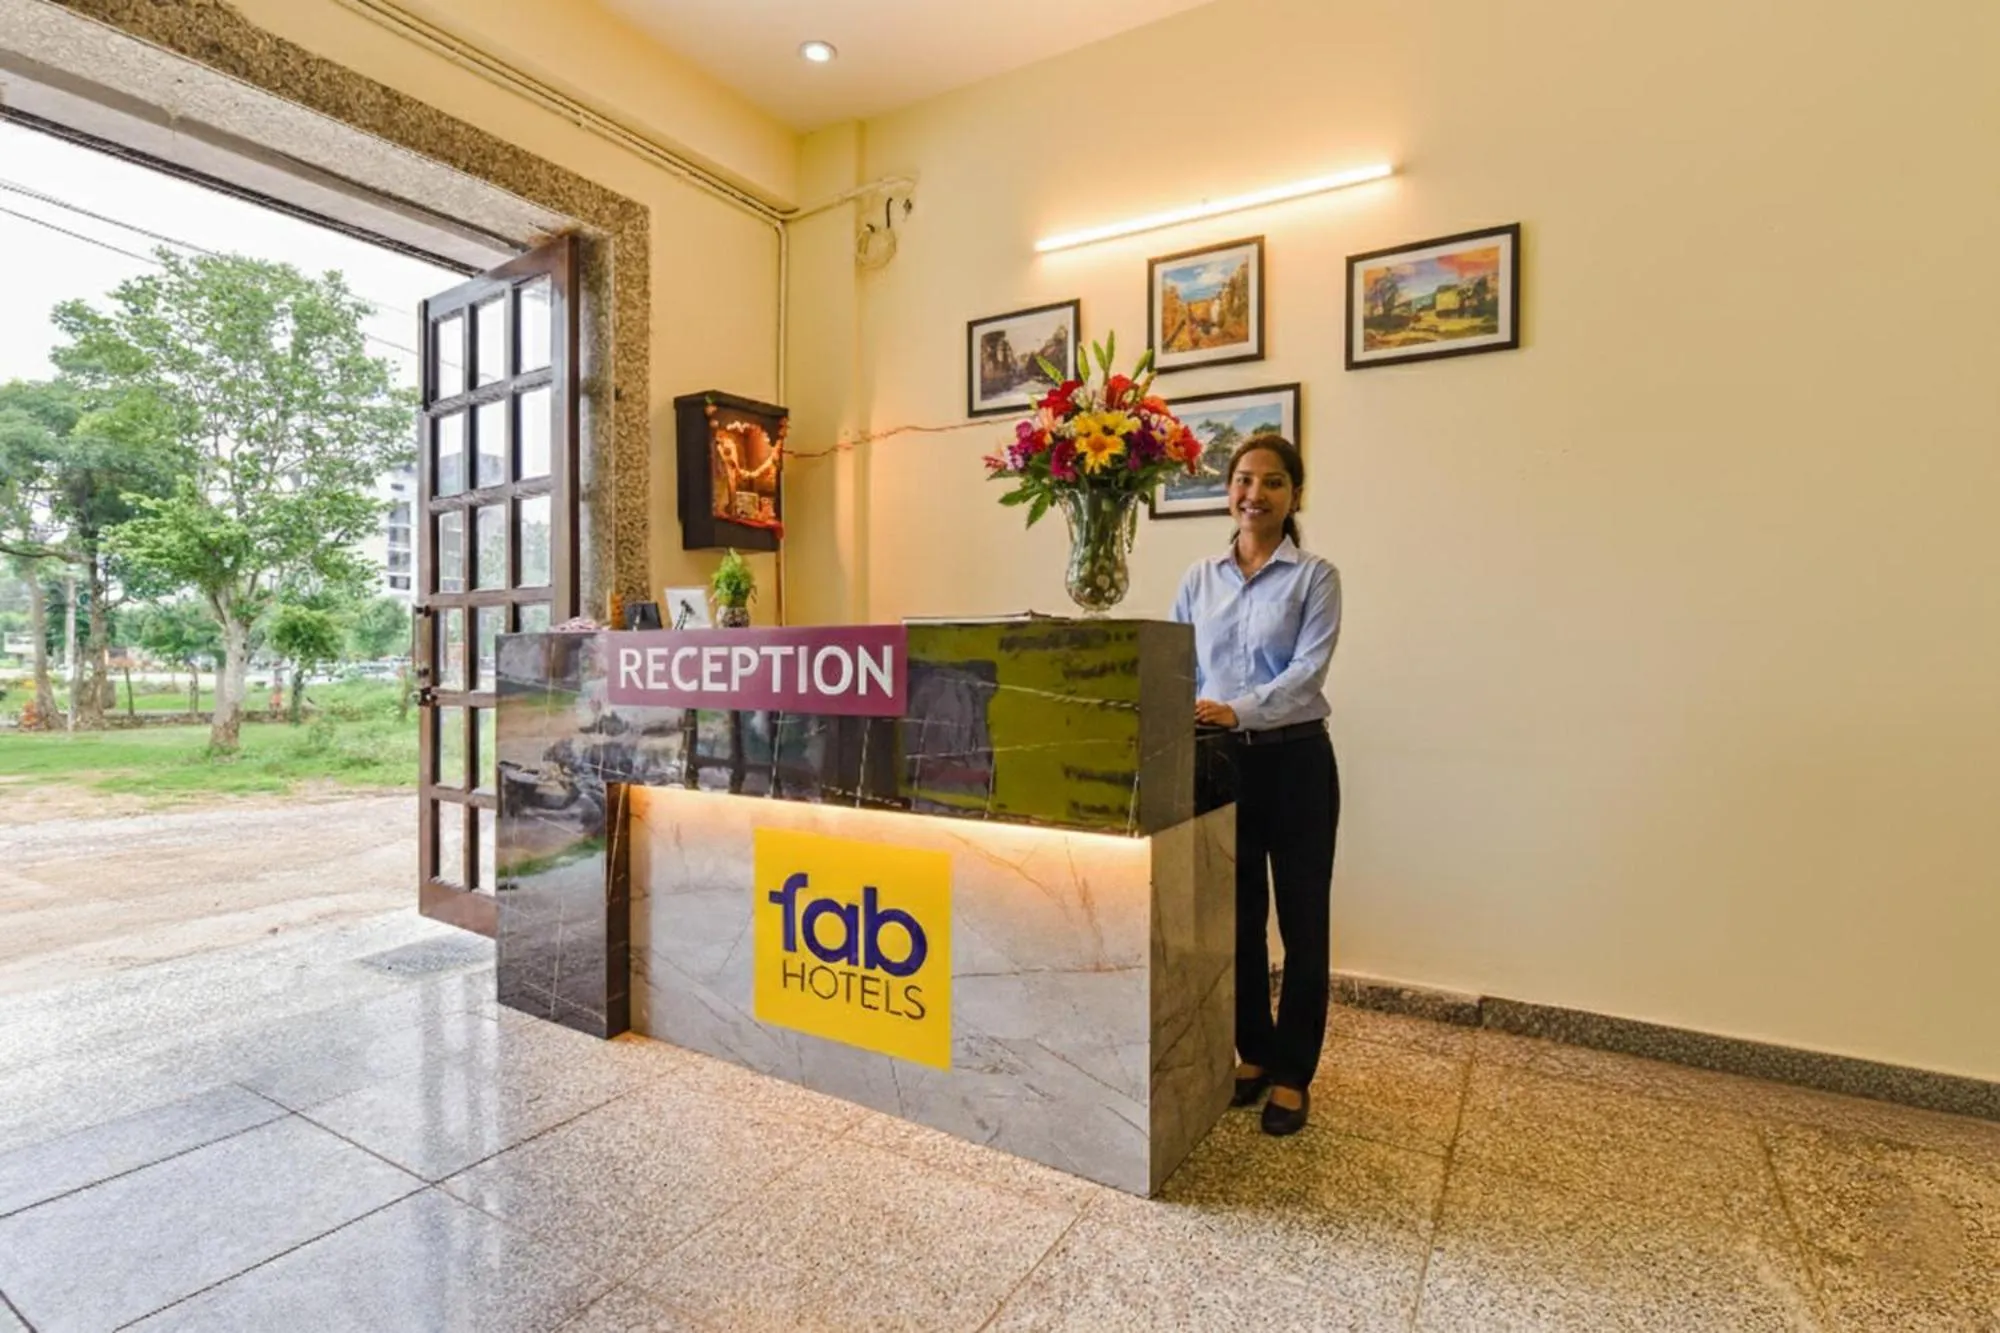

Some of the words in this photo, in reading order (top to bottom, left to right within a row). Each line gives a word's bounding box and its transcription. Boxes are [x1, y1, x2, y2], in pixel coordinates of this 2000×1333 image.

[619, 645, 893, 698] RECEPTION
[768, 872, 928, 976] fab
[783, 960, 926, 1020] HOTELS
